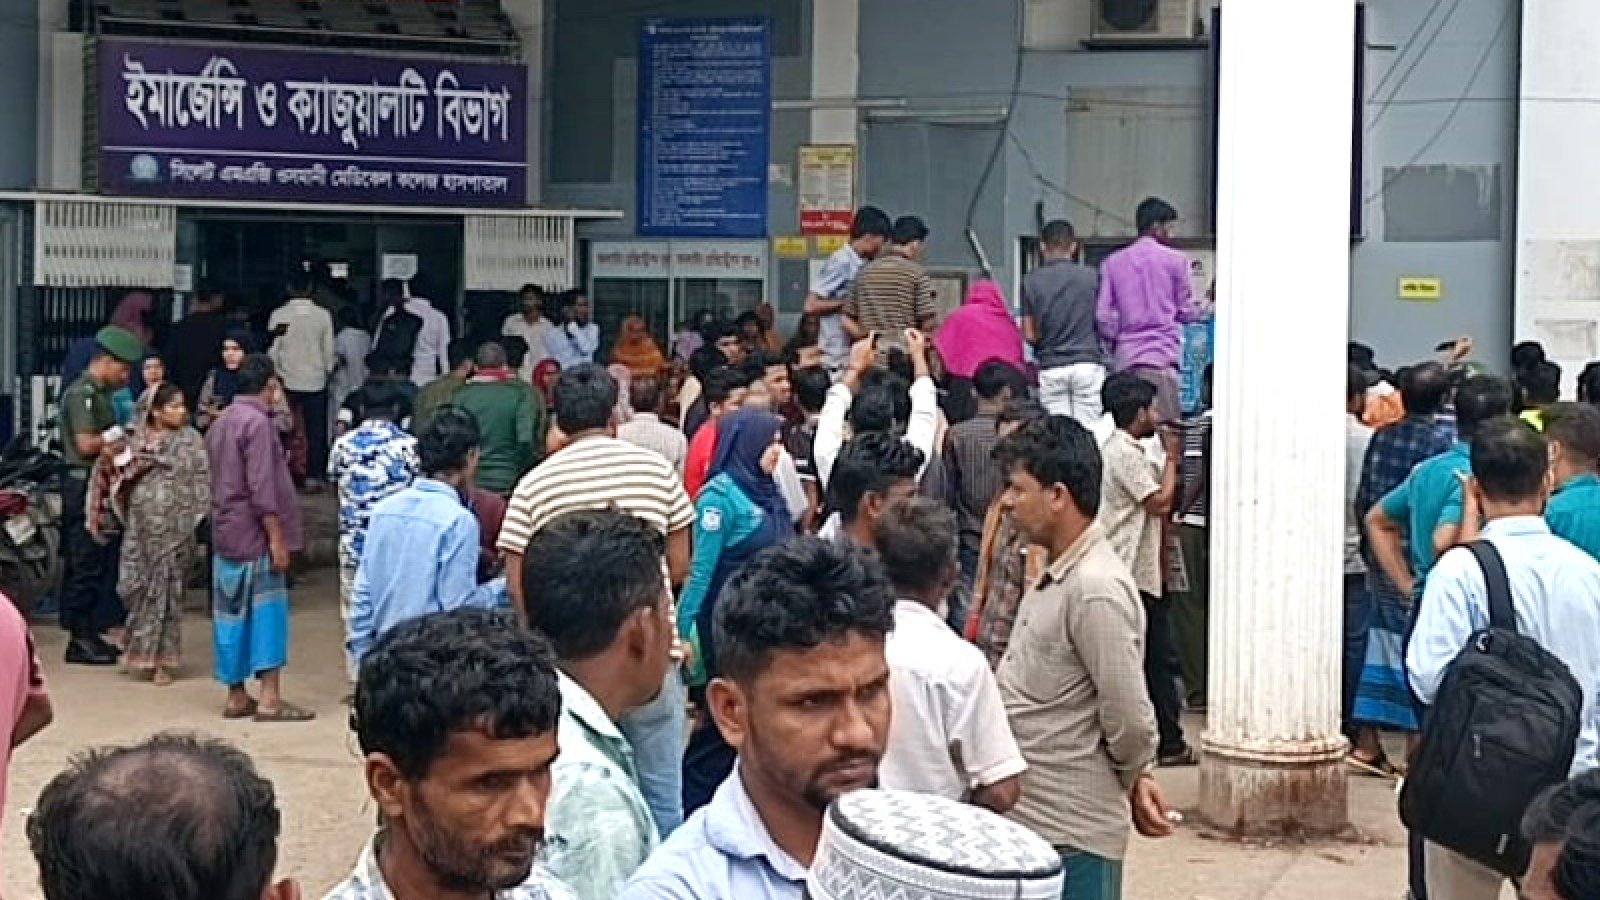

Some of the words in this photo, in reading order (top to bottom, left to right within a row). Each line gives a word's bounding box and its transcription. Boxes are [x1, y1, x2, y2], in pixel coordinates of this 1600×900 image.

[122, 52, 246, 129] ইমার্জেন্সি
[254, 81, 277, 127] ও
[433, 69, 511, 141] বিভাগ
